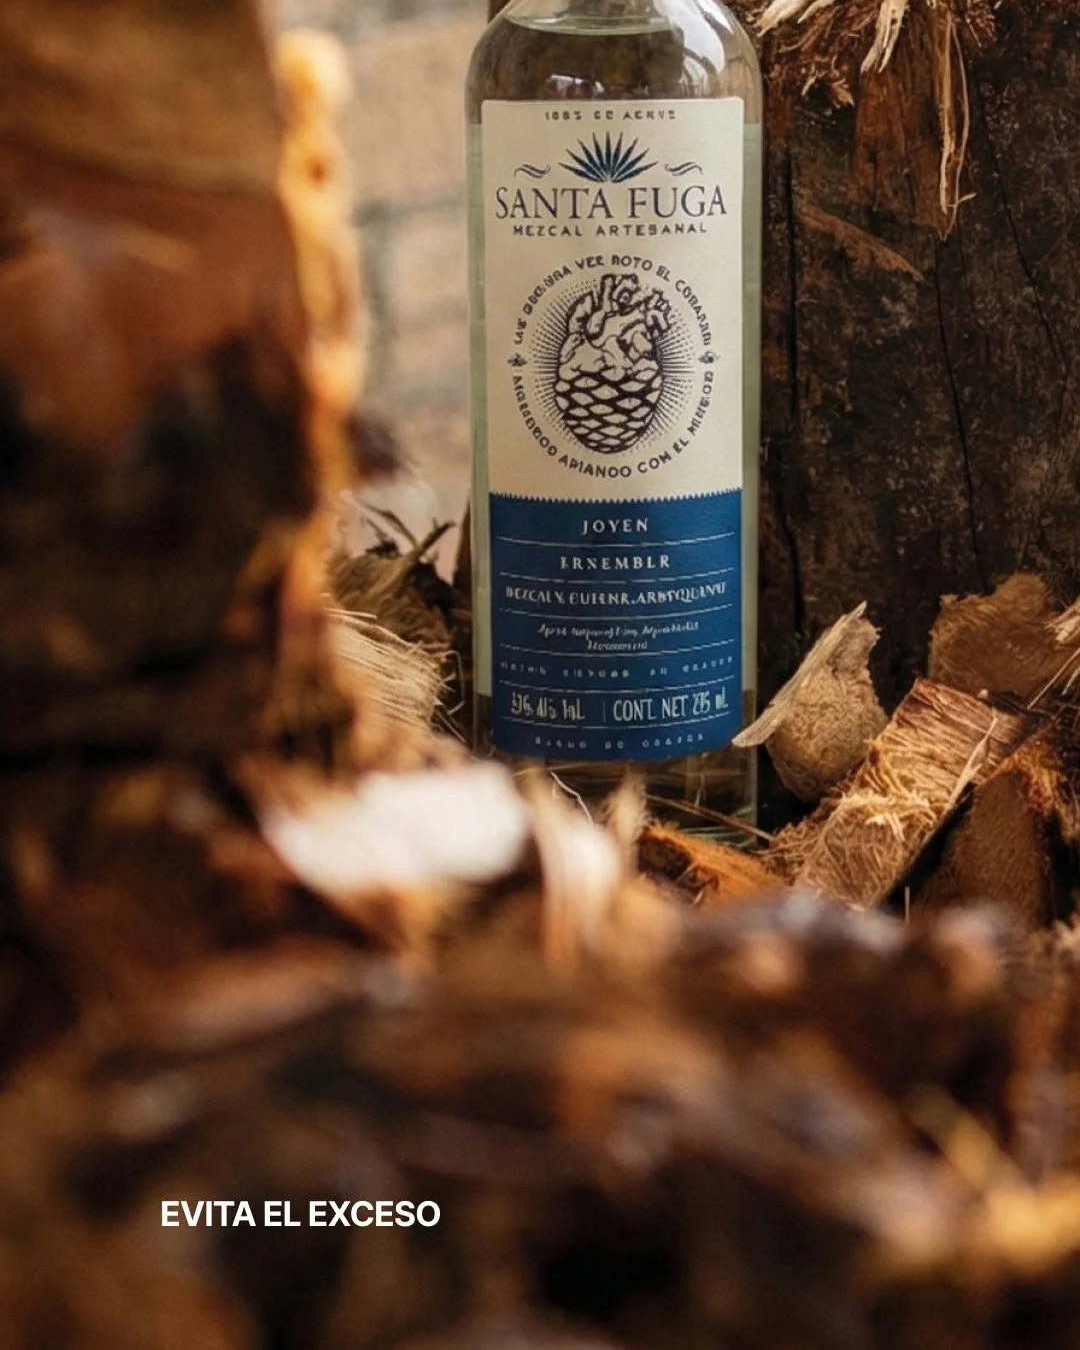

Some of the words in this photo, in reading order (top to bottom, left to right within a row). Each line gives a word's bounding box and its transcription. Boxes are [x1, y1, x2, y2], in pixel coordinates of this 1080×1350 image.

[495, 186, 614, 219] SANTA
[627, 185, 728, 219] FUGA
[513, 224, 583, 237] MEZCAL
[595, 222, 707, 237] ARTESANAL
[581, 518, 649, 535] JOYEN
